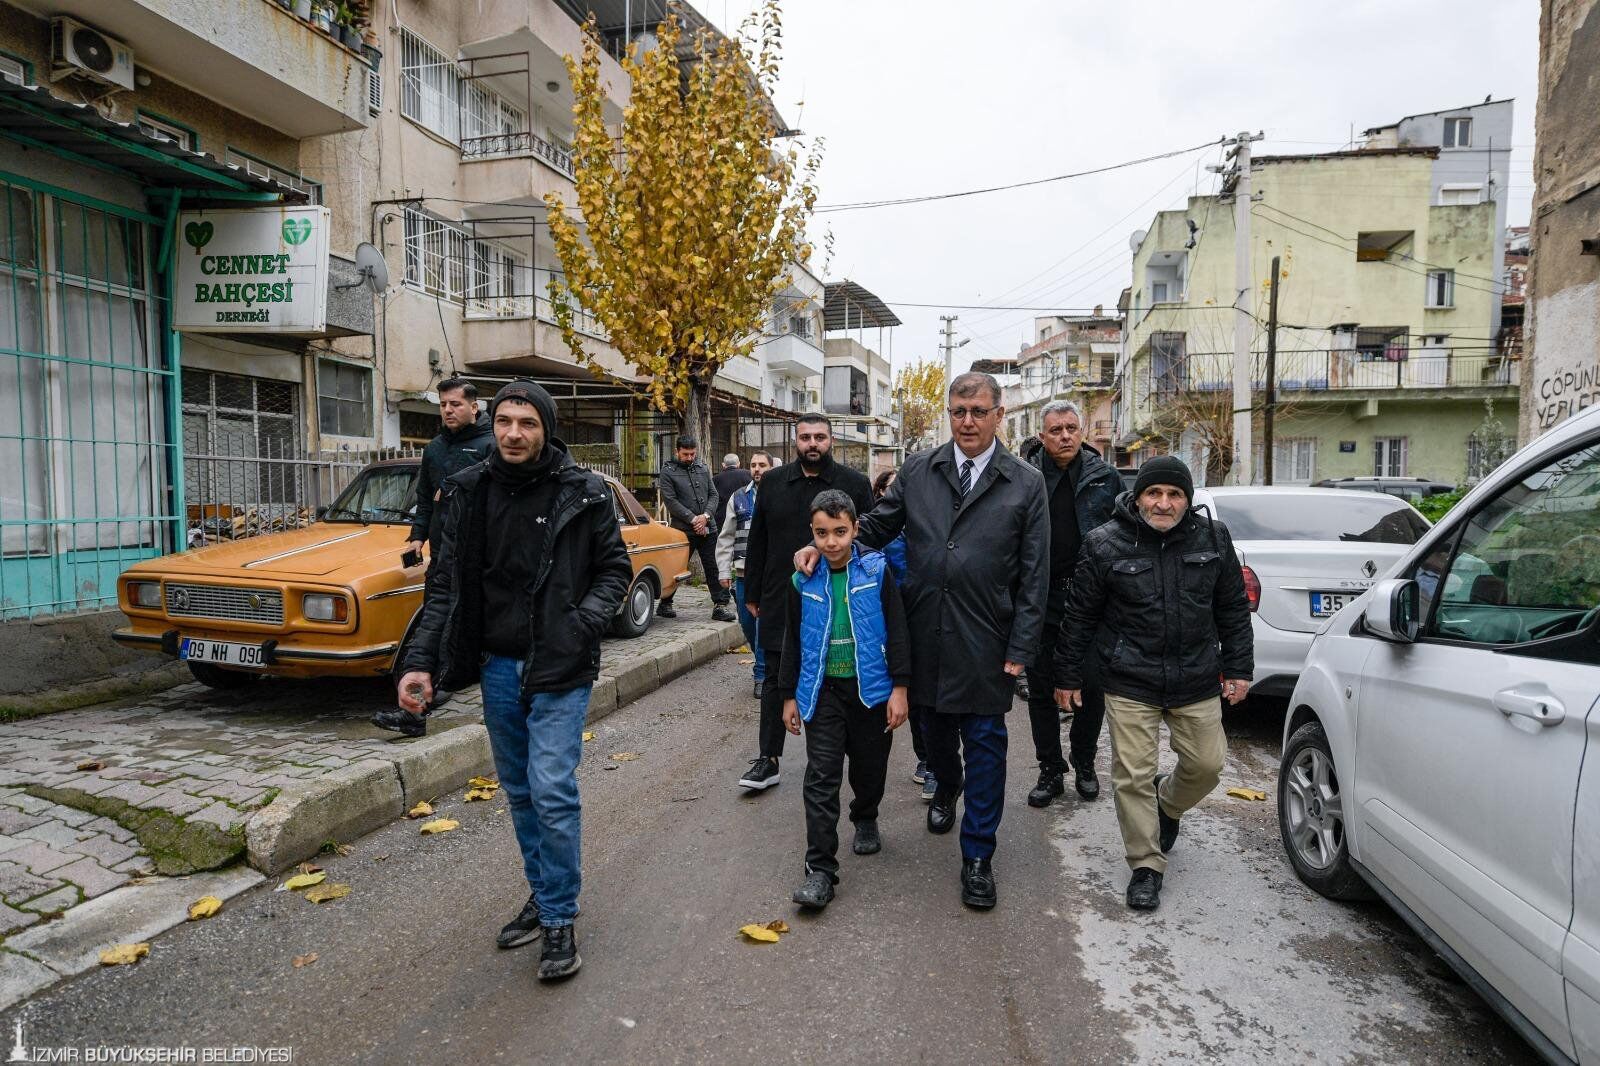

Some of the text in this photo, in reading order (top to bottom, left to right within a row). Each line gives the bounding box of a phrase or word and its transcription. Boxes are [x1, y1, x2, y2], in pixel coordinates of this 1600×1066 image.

[200, 254, 290, 275] CENNET
[195, 278, 293, 307] BAHÇESİ
[216, 309, 270, 322] DERNEĞİ
[1323, 595, 1343, 611] 35
[189, 641, 205, 658] 09
[211, 643, 229, 661] NH
